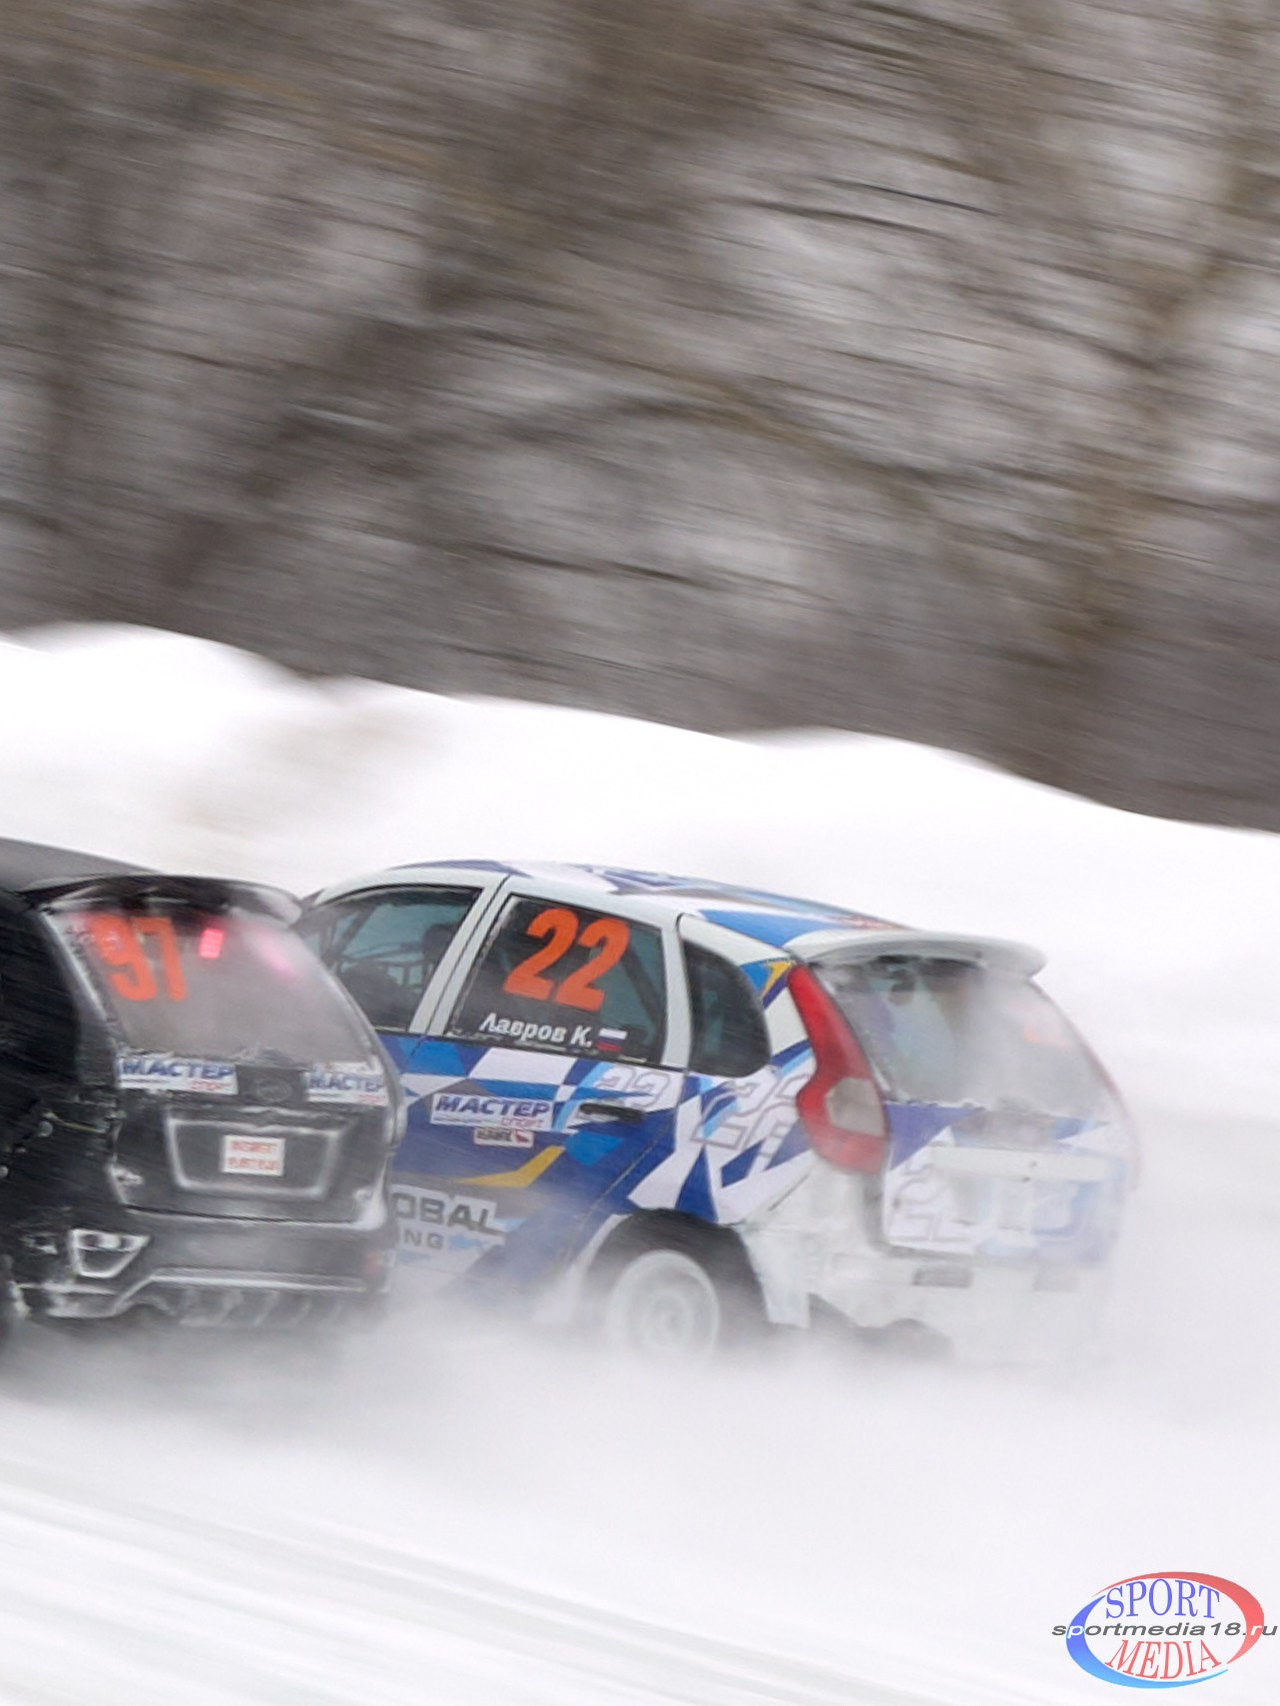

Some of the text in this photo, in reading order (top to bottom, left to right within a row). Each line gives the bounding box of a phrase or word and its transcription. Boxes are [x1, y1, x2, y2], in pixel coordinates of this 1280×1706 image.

[88, 912, 188, 1001] 97
[503, 907, 631, 1012] 22
[479, 1012, 593, 1048] Лавров К.
[122, 1058, 237, 1081] МАСТЕР
[435, 1095, 551, 1117] МАСТЕР
[390, 1191, 503, 1236] OBAL
[403, 1228, 443, 1249] NG
